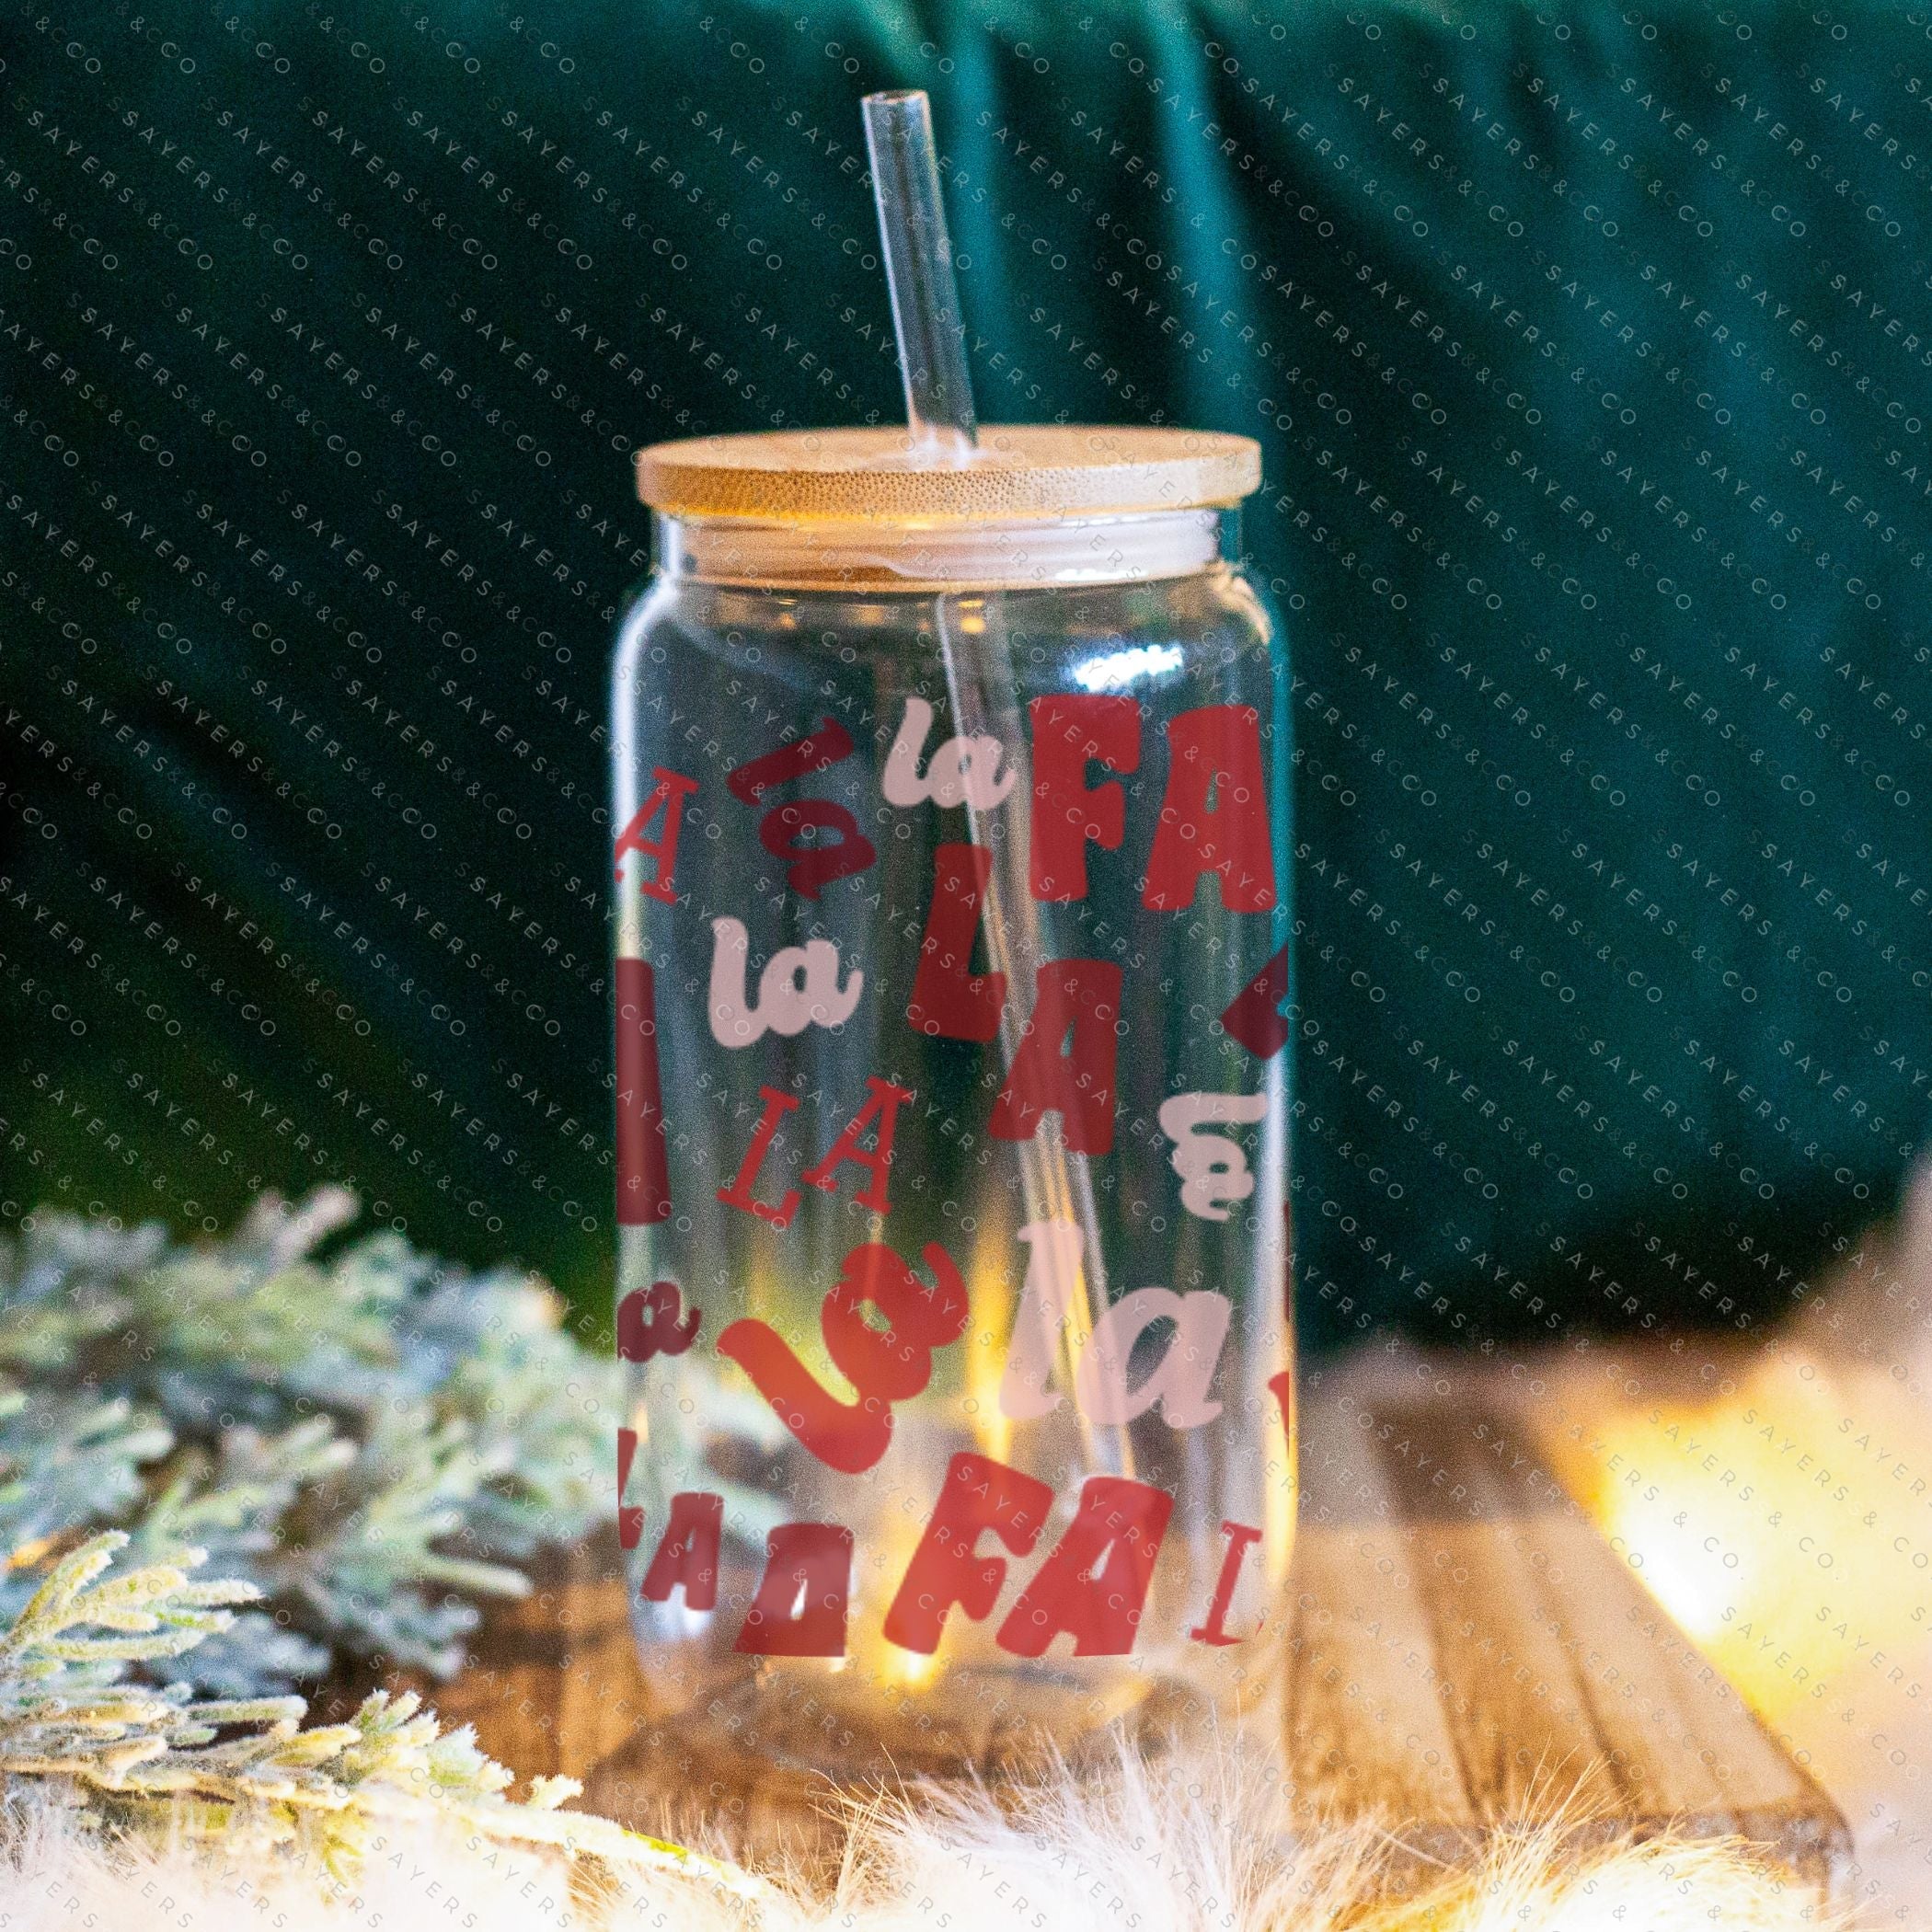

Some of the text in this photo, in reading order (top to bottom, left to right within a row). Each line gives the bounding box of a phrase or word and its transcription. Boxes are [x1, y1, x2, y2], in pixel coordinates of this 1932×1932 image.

[883, 696, 1015, 811] la
[1029, 694, 1278, 914] FA
[708, 915, 864, 1050] la
[905, 842, 1124, 1157] LA
[716, 1075, 914, 1228] LA
[716, 1242, 970, 1474] la
[999, 1219, 1232, 1429] la
[883, 1451, 1175, 1657] FA
